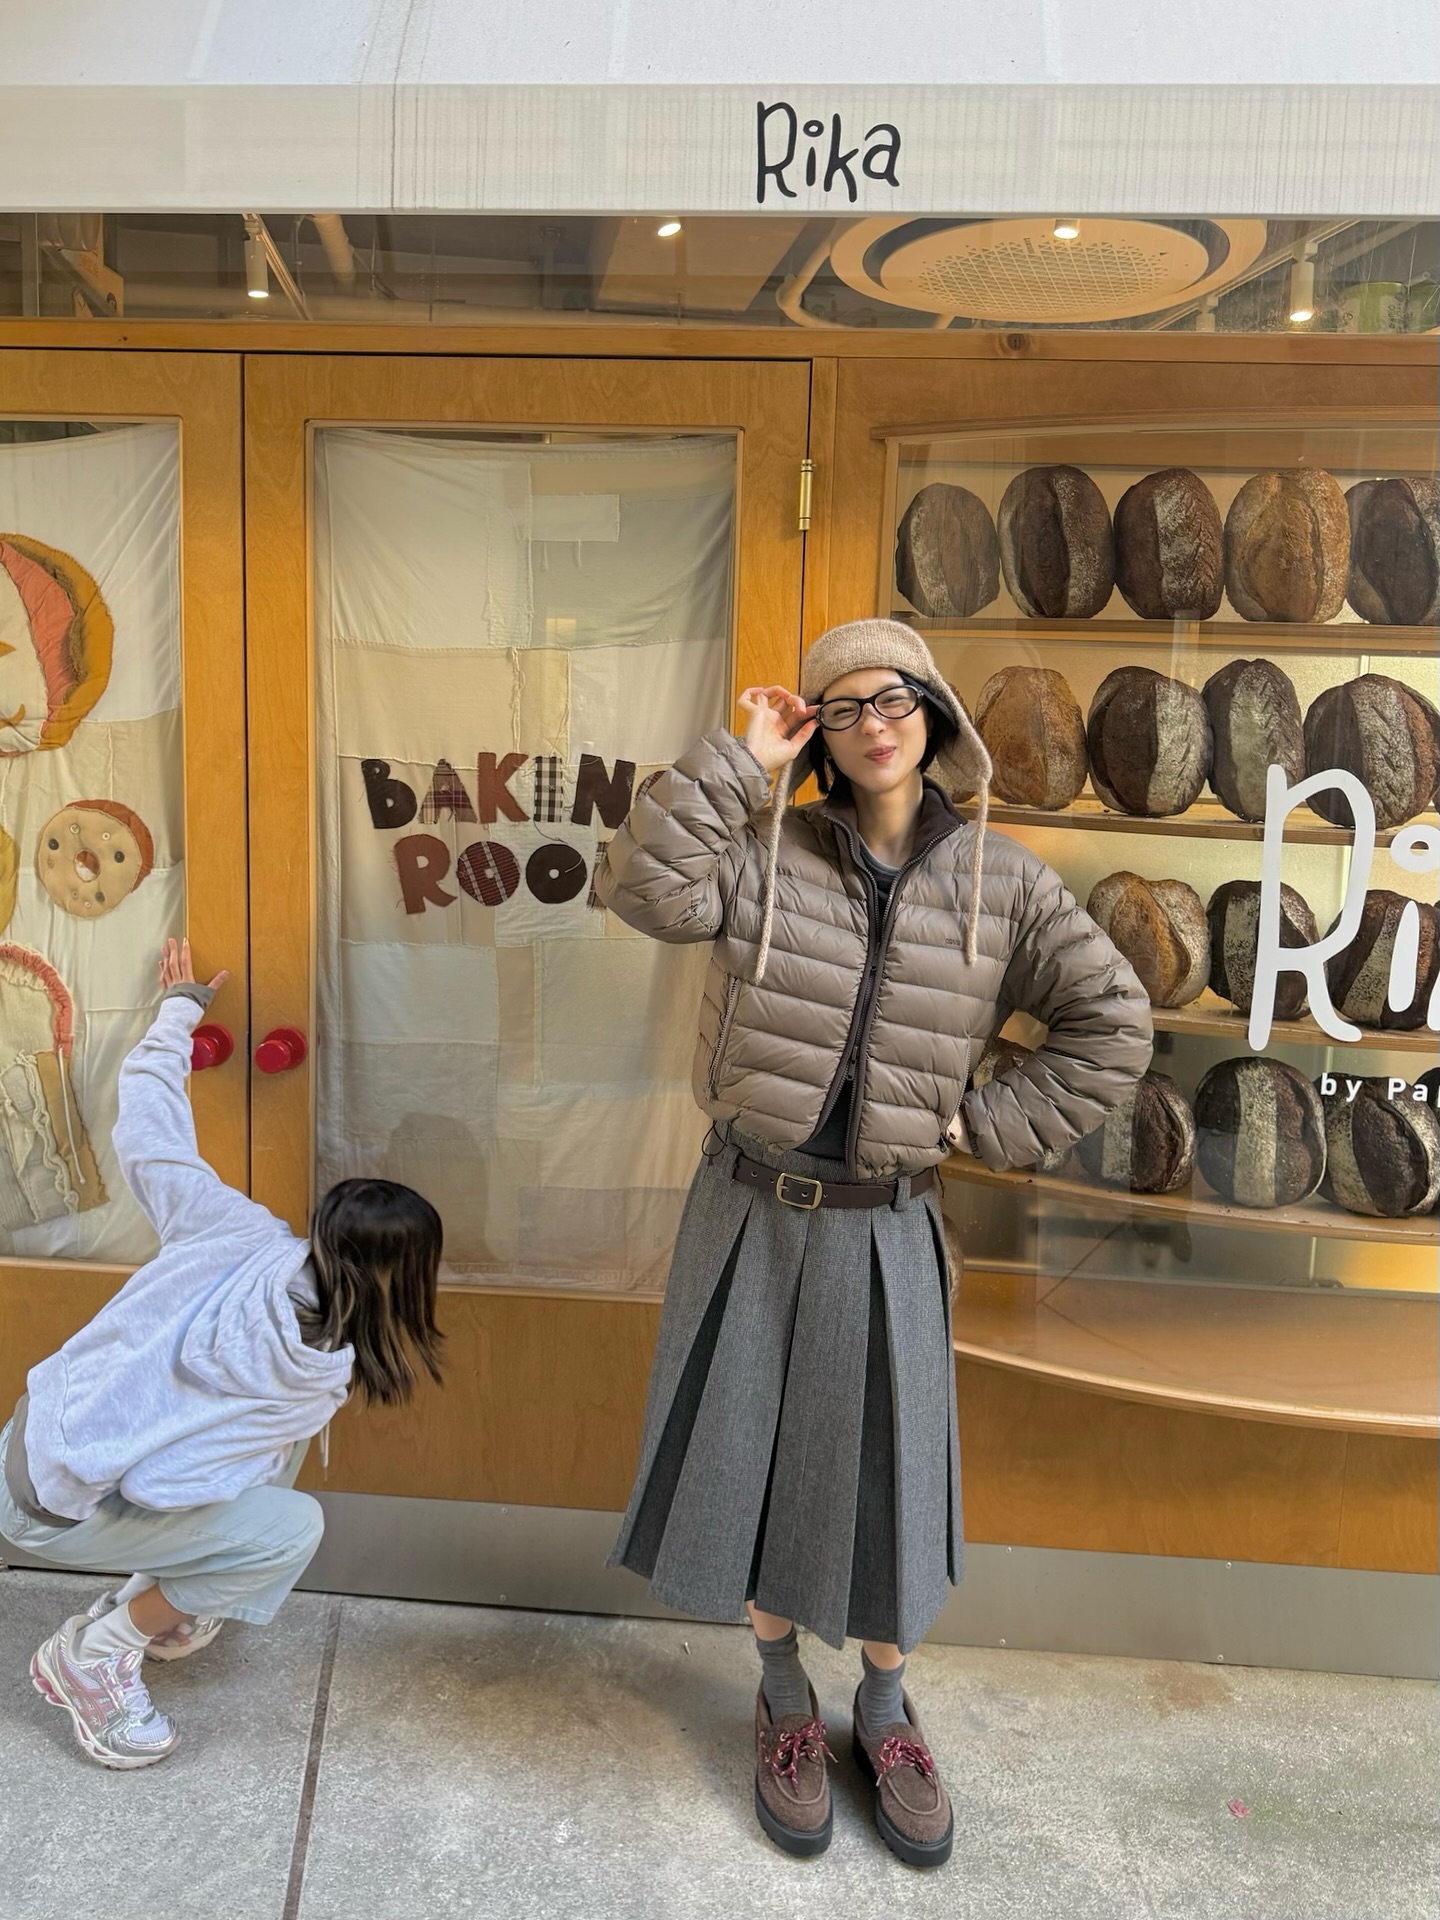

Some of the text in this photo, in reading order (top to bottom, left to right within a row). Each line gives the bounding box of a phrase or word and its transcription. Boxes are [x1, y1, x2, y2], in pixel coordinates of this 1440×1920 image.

[757, 101, 901, 204] Rika
[361, 751, 665, 829] BAKIN
[393, 834, 610, 914] ROO
[1249, 764, 1440, 1051] Ri
[1321, 1072, 1440, 1109] by Pa
